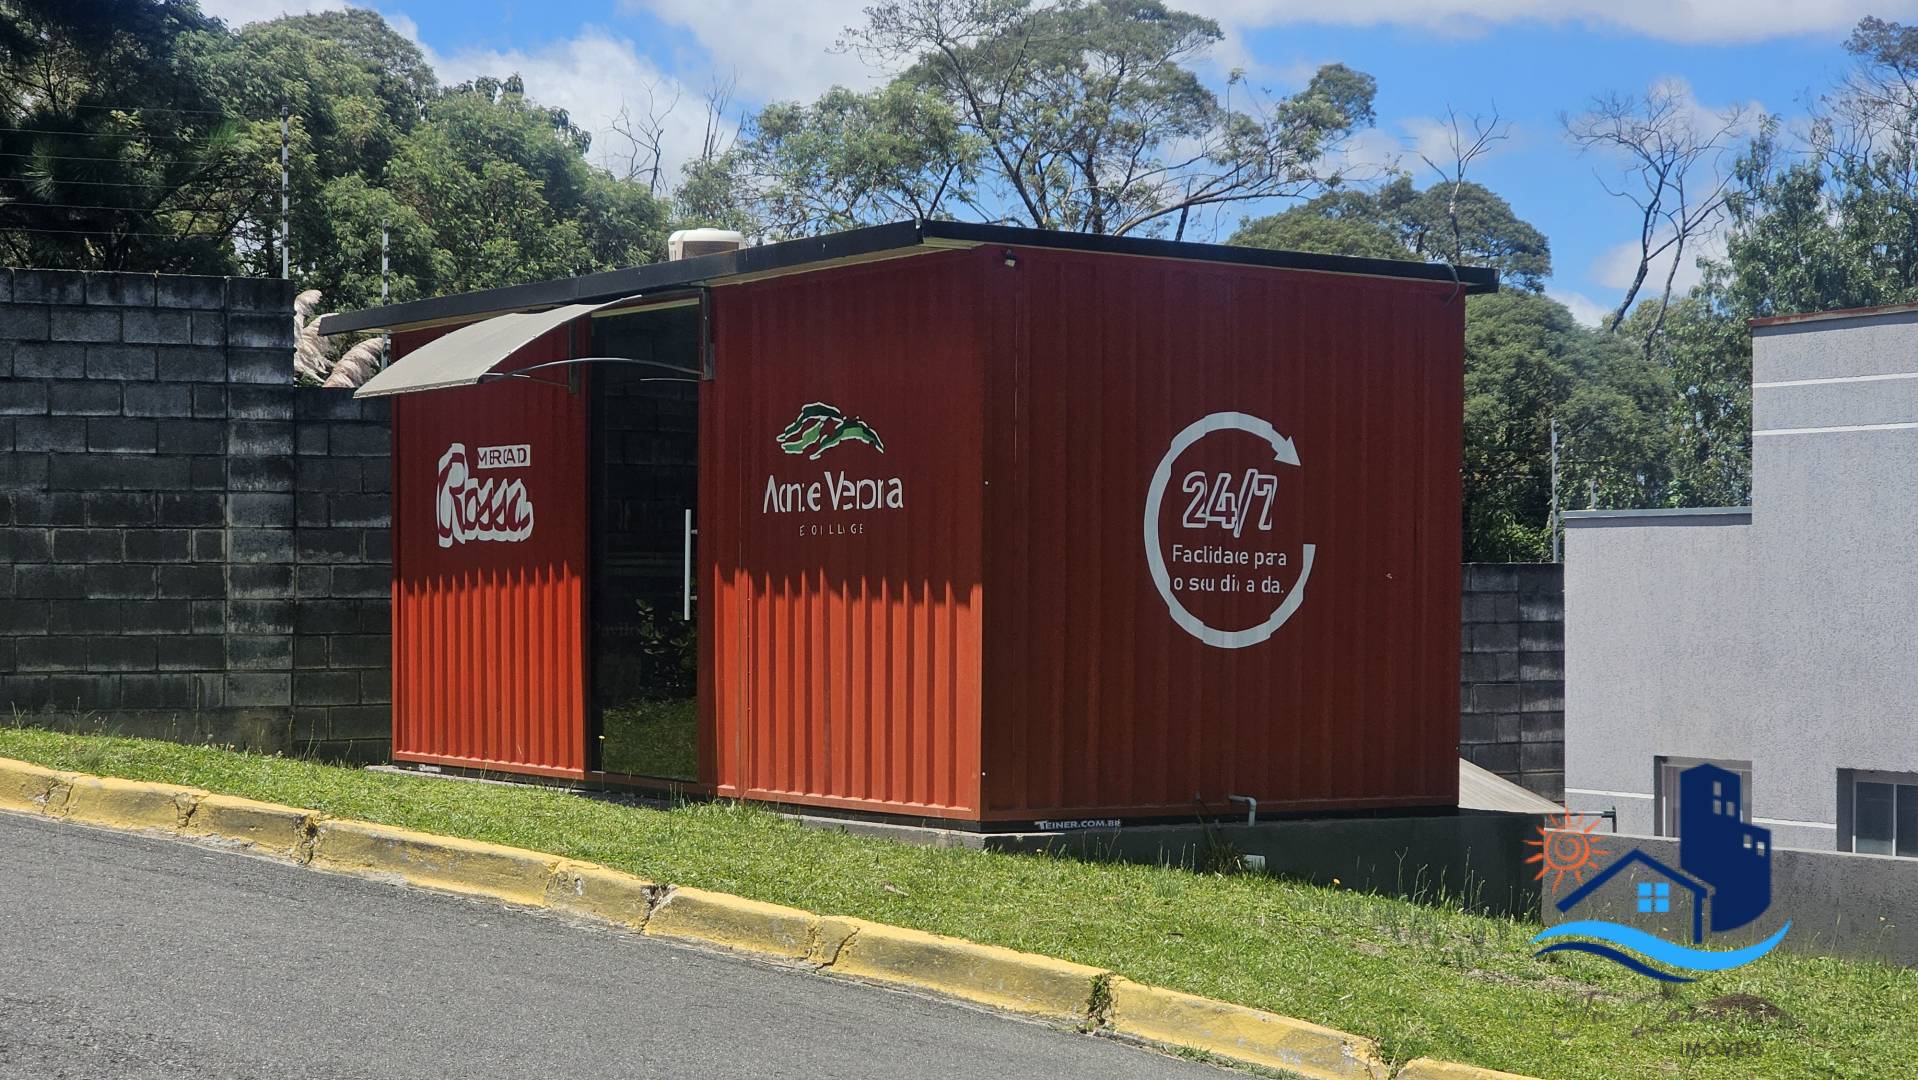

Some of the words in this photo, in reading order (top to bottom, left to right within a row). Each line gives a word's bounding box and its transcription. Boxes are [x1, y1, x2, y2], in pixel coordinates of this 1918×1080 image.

[1182, 468, 1278, 538] 24/7
[1254, 551, 1287, 570] para
[1173, 577, 1184, 591] o
[1246, 579, 1255, 593] a
